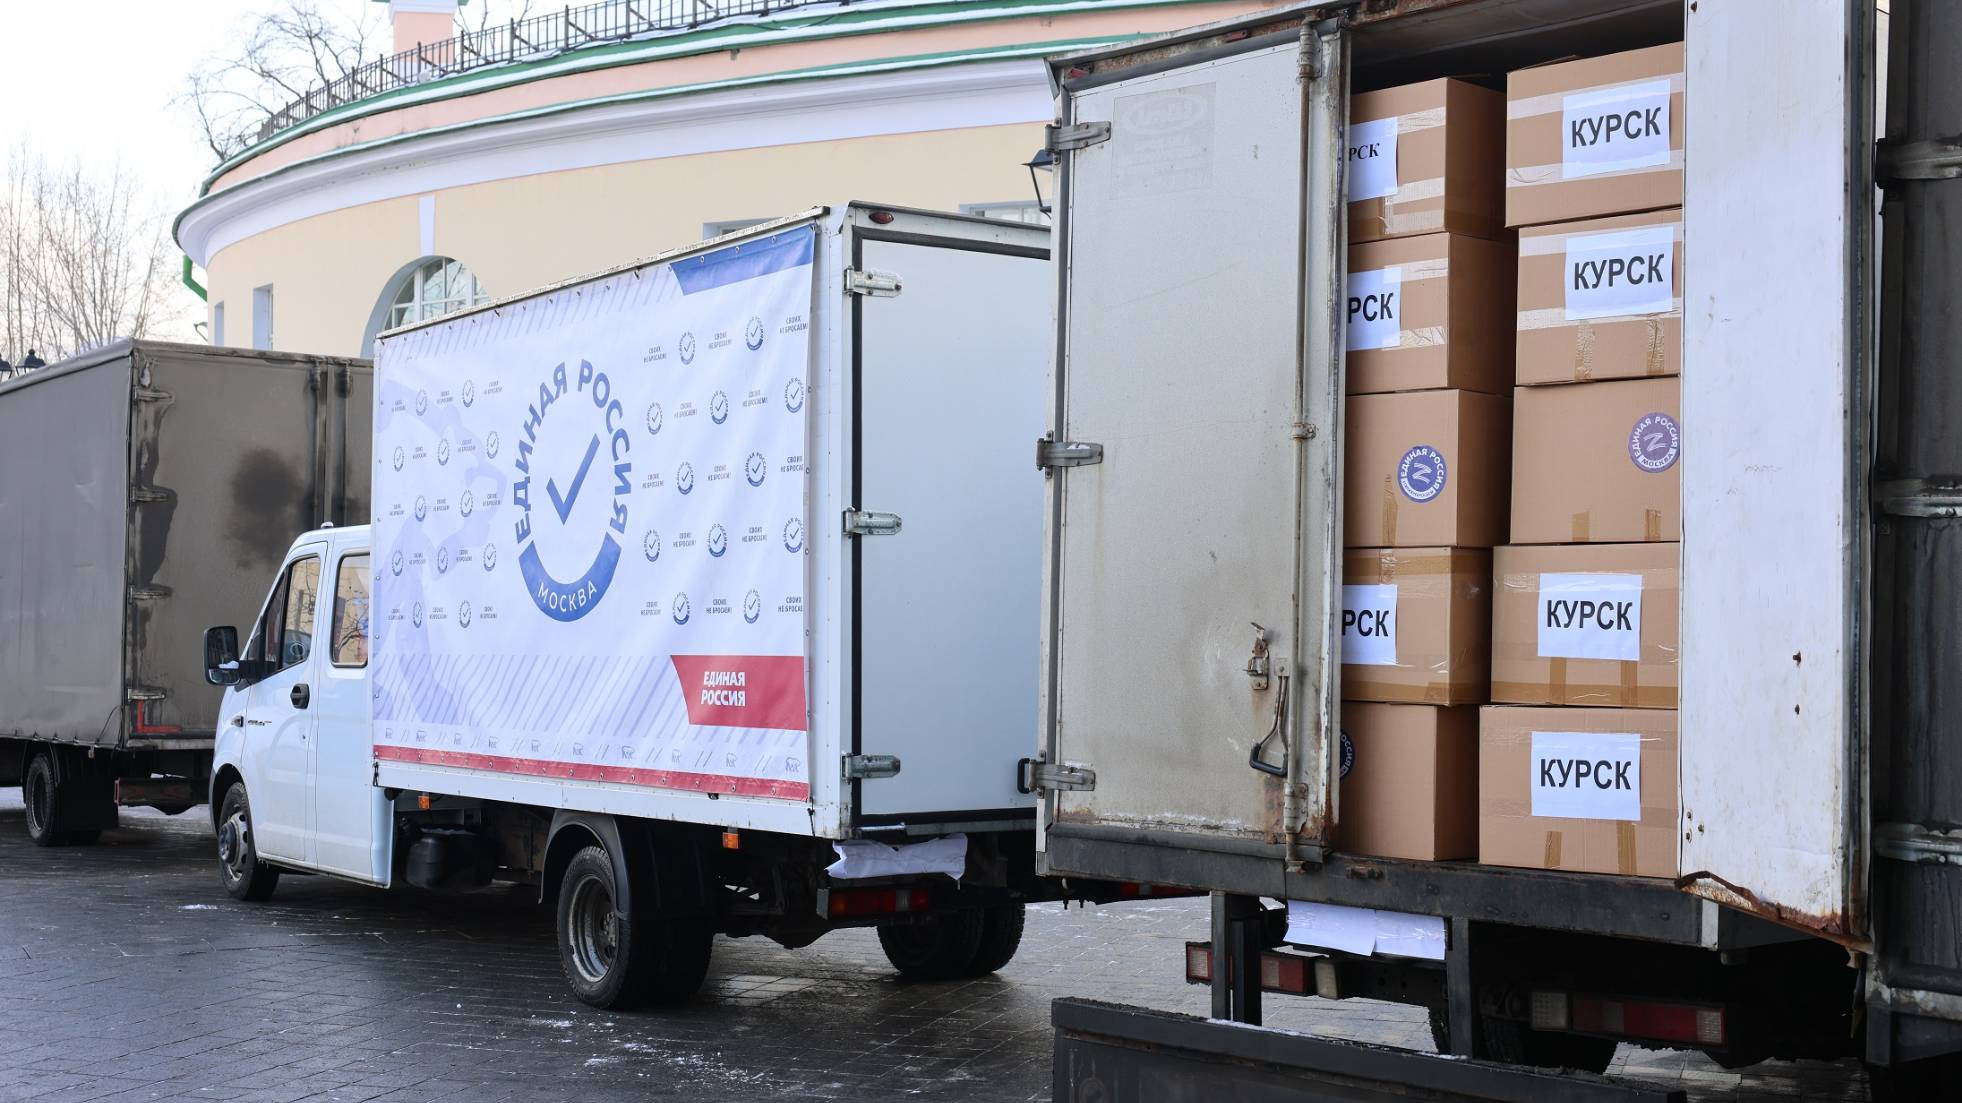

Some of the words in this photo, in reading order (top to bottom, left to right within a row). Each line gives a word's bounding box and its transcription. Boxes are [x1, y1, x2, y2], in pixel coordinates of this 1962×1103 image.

[1571, 106, 1661, 148] КУРСК
[1349, 142, 1380, 161] РСК
[1574, 253, 1665, 290] КУРСК
[1348, 292, 1394, 324] РСК
[514, 361, 568, 544] ЕДИНАЯ
[578, 359, 631, 534] РОССИЯ
[1632, 417, 1652, 457] ЕДИНАЯ
[1654, 416, 1678, 447] РОССИЯ
[1401, 448, 1428, 477] ЕДИНАЯ
[1429, 451, 1444, 489] РОССИЯ
[538, 580, 597, 612] МОСКВА
[1342, 609, 1389, 637] РСК
[1547, 599, 1633, 630] КУРСК
[703, 671, 746, 688] ЕДИНАЯ
[700, 689, 746, 707] РОССИЯ
[1340, 734, 1353, 767] ОССИЯ
[1540, 758, 1631, 790] КУРСК
